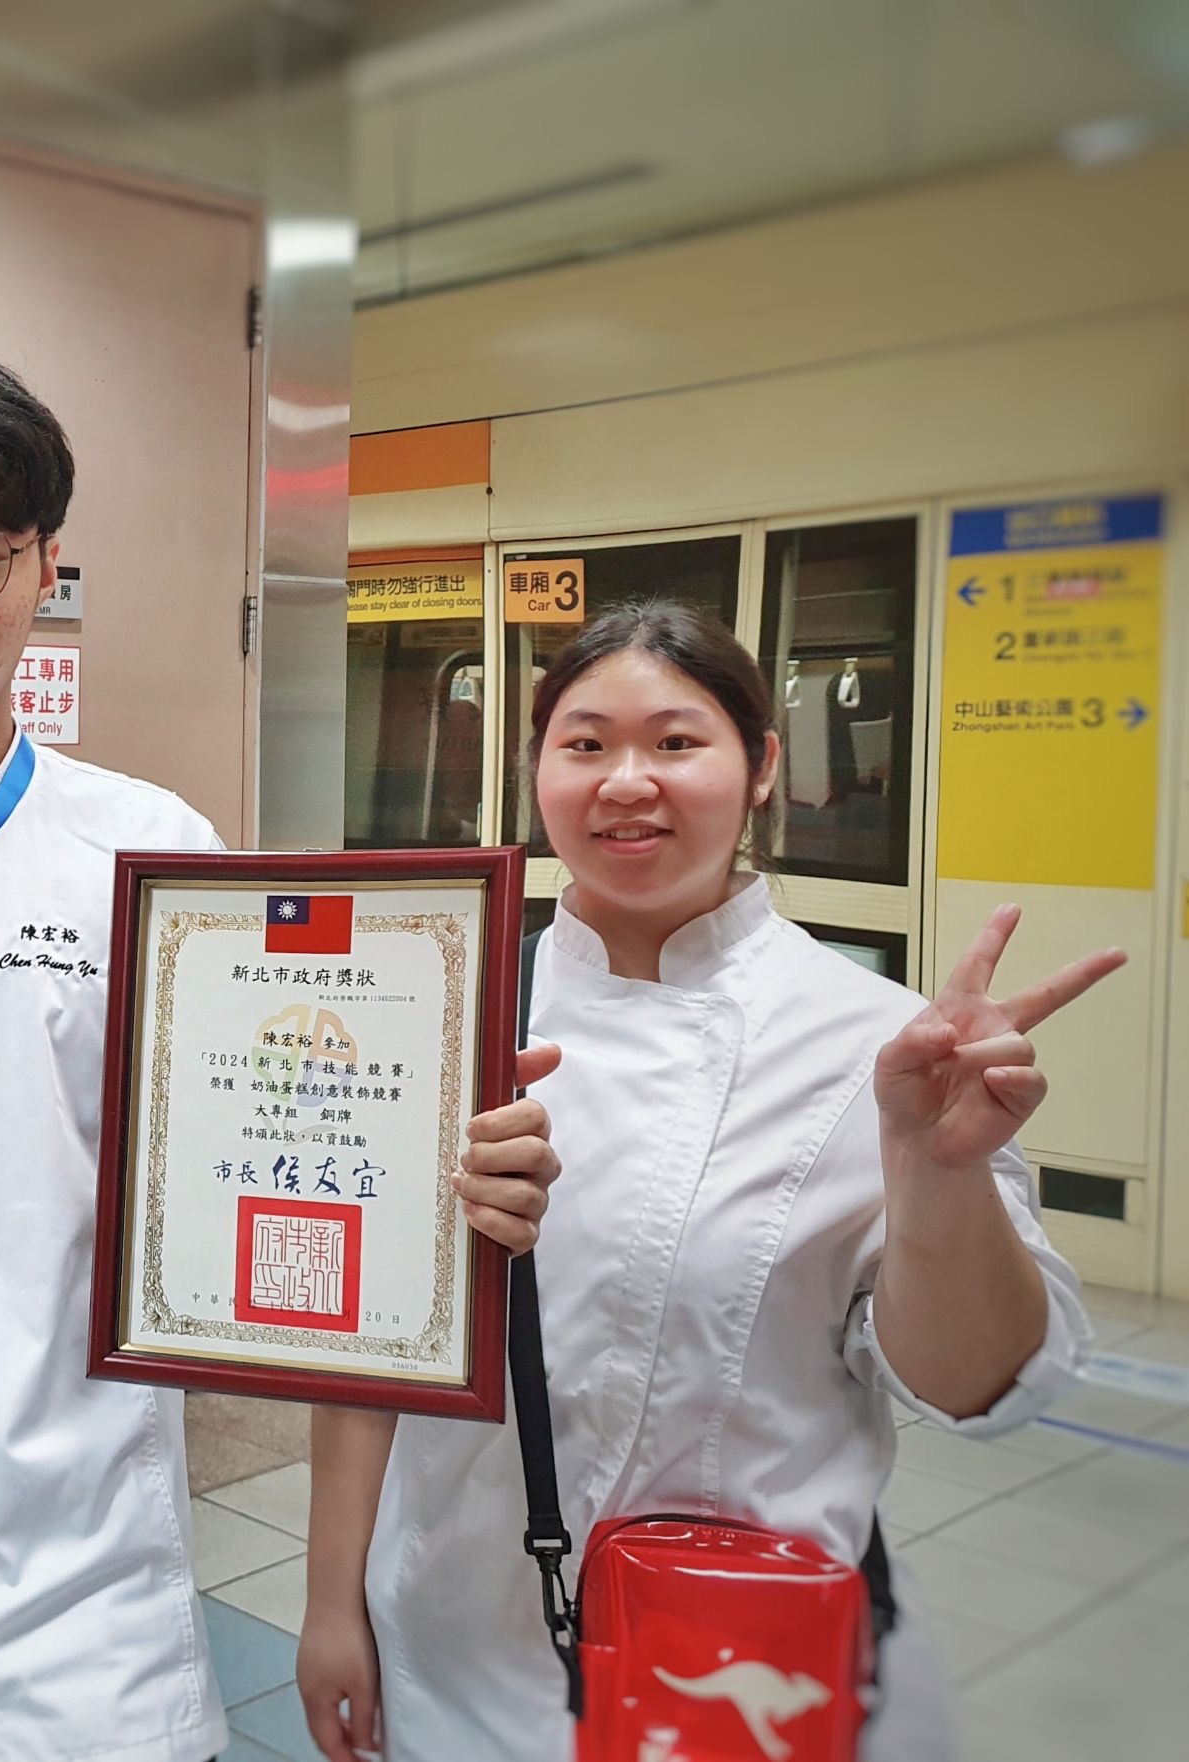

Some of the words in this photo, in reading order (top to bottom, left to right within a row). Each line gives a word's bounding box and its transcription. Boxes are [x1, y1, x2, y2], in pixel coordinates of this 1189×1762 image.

[509, 571, 550, 595] 車廂
[554, 570, 580, 612] 3
[346, 601, 369, 612] lease
[370, 600, 388, 613] stay
[389, 598, 410, 610] clear
[411, 598, 422, 609] of
[422, 595, 456, 609] closing
[527, 599, 552, 612] Car
[994, 631, 1017, 662] 2
[12, 658, 75, 683] 工專用
[1080, 697, 1106, 729] 3
[37, 721, 63, 737] Only
[20, 924, 80, 943] 陳宏裕
[35, 954, 74, 976] Hung
[77, 960, 99, 978] Yu
[231, 964, 377, 988] 新北市政府獎狀
[263, 1031, 313, 1048] 陳宏裕
[323, 1036, 350, 1050] 參加
[210, 1076, 236, 1092] 榮獲
[250, 1079, 403, 1102] 奶油蛋糕創意裝飾競賽
[254, 1103, 299, 1119] 大專組
[320, 1107, 353, 1123] 銅牌
[212, 1160, 258, 1185] 市長
[272, 1154, 387, 1199] 侯友宜
